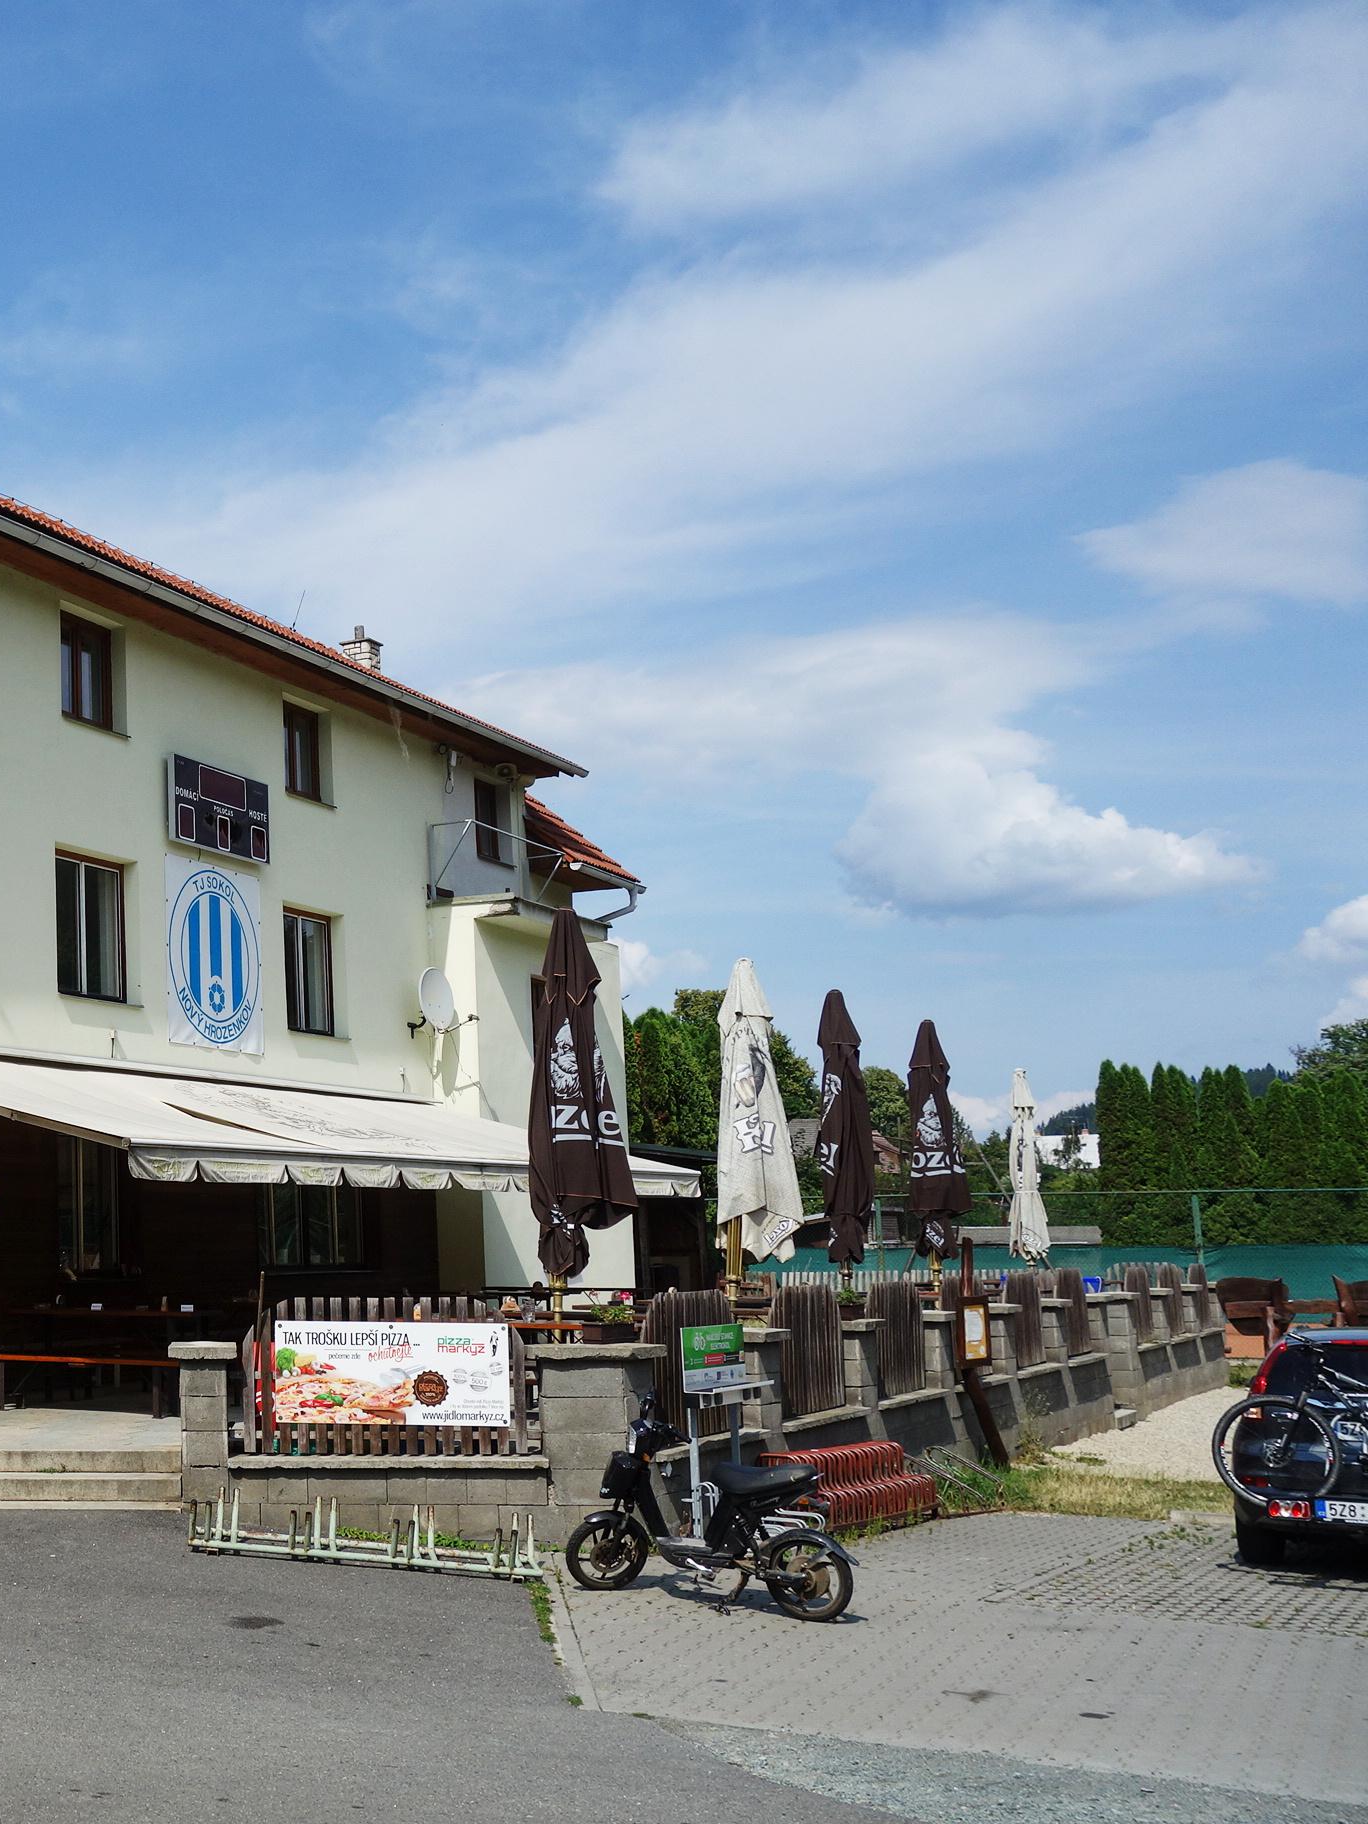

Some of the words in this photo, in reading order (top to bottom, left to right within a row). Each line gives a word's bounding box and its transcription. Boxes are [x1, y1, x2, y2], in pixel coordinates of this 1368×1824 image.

[175, 785, 199, 802] DOMÁCÍ
[192, 877, 205, 892] TJ
[206, 876, 235, 904] SOKOL
[179, 987, 204, 1027] NOVÝ
[203, 998, 253, 1040] HROZENKOV
[283, 1331, 303, 1345] TAK
[305, 1329, 347, 1346] TROŠKU
[350, 1329, 379, 1346] LEPŠÍ
[381, 1332, 410, 1347] PIZZA
[437, 1336, 471, 1346] pizza
[351, 1352, 361, 1360] zde
[437, 1343, 486, 1356] markyz
[1329, 1503, 1357, 1518] 5Z8
